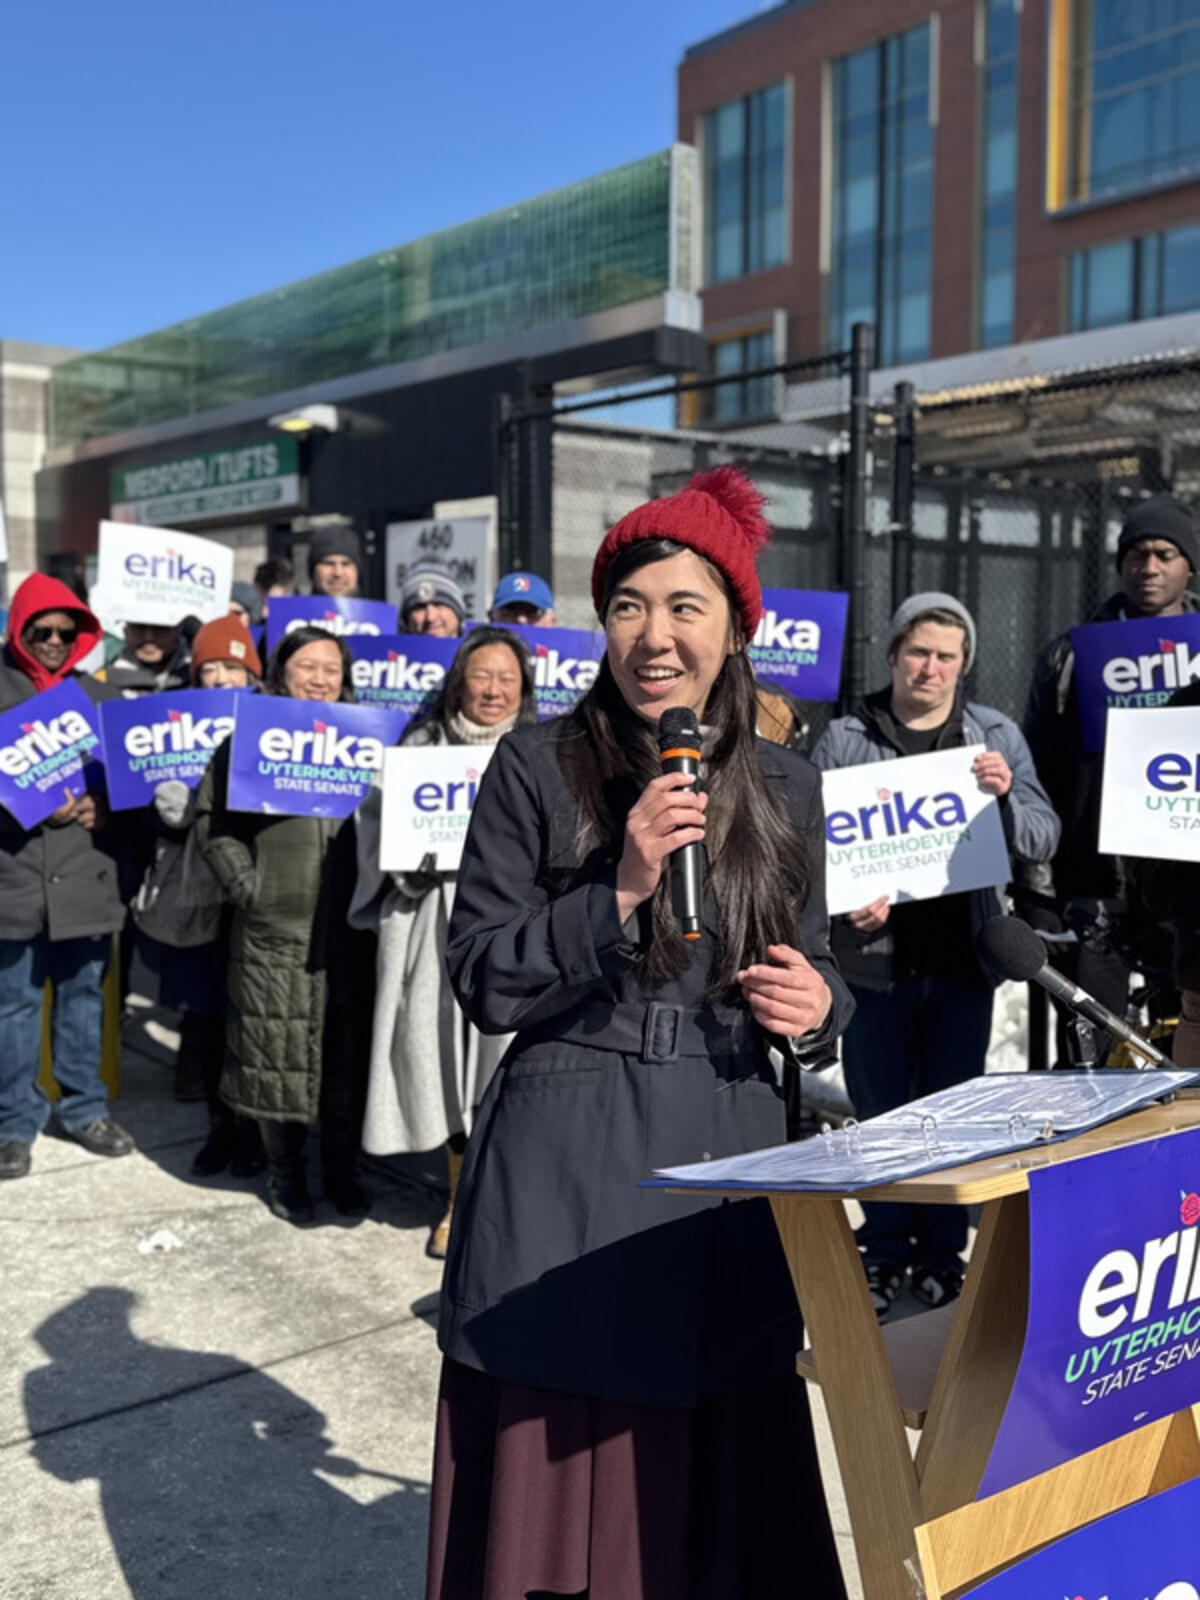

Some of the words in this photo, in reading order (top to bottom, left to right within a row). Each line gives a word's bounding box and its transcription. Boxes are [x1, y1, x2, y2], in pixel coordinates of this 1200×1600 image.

[124, 548, 216, 590] erika
[351, 651, 445, 690] erika
[0, 710, 92, 776] erika
[124, 709, 235, 757] erika
[258, 719, 384, 769] erika
[144, 766, 177, 783] STATE
[273, 776, 312, 793] STATE
[313, 781, 362, 798] SENATE
[826, 787, 968, 845] erika
[829, 828, 972, 866] UYTERHOEVEN
[850, 860, 893, 879] STATE
[1078, 1190, 1200, 1339] eri
[1081, 1356, 1152, 1405] STATE
